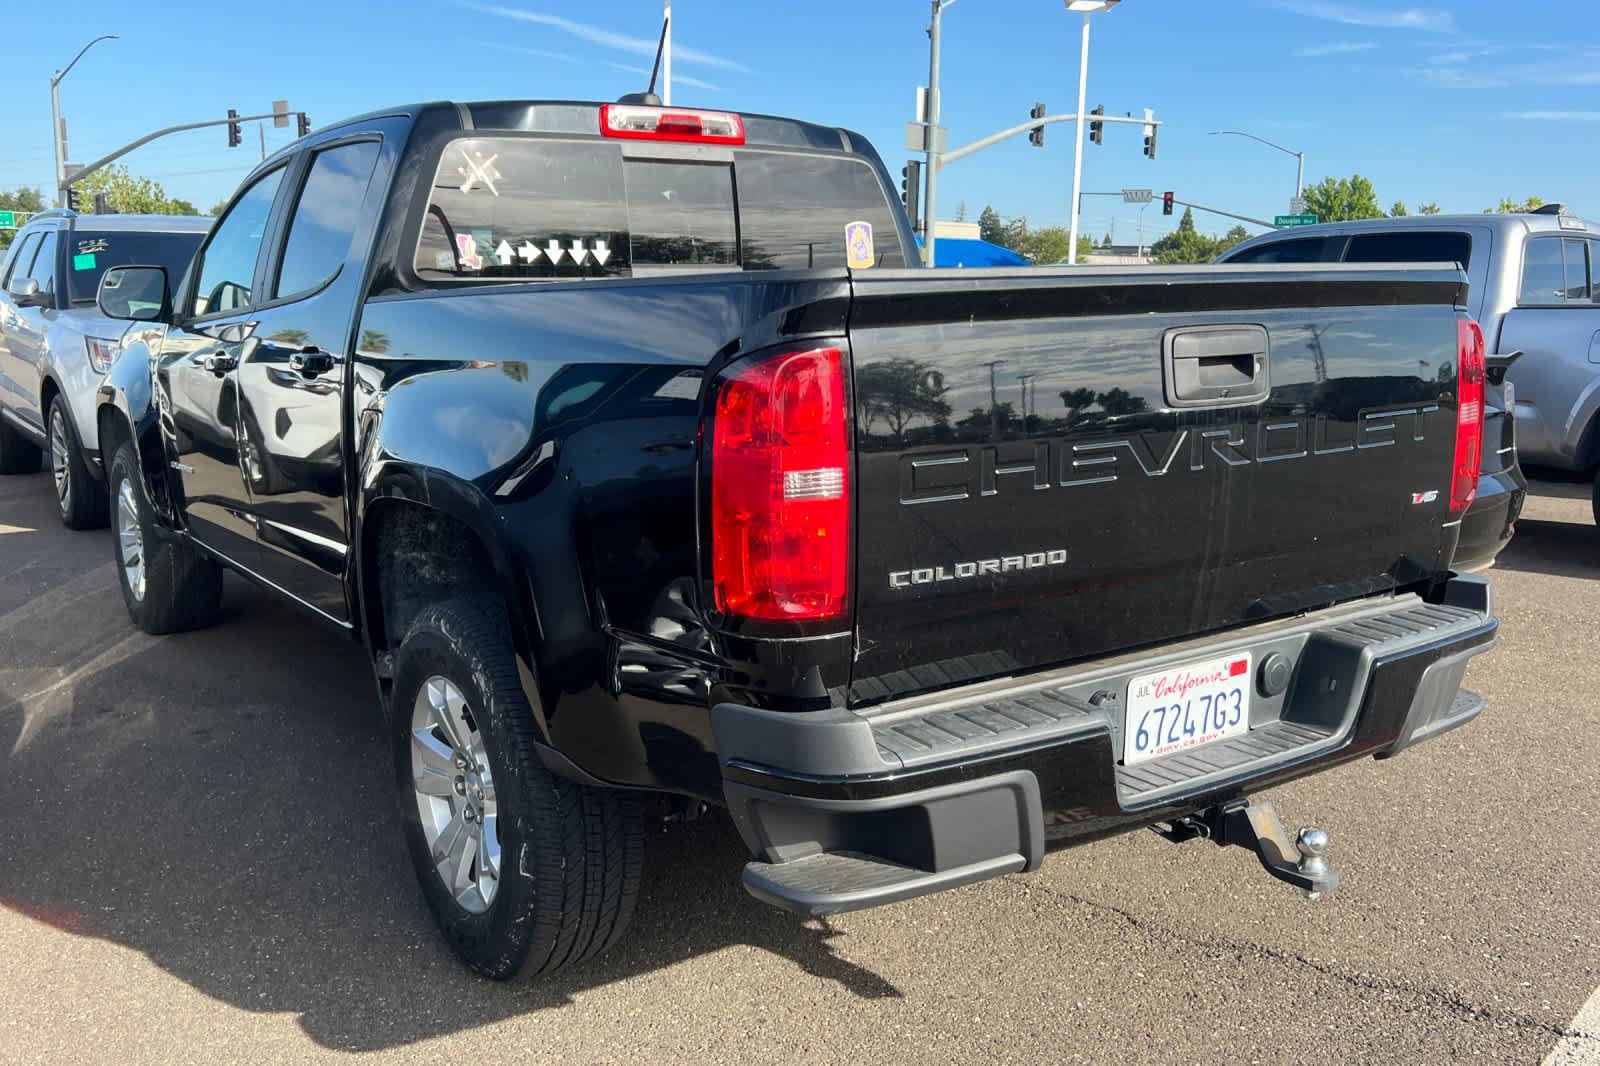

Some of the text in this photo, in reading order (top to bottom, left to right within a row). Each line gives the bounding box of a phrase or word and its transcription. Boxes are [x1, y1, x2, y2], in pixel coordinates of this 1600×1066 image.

[899, 406, 1439, 505] CHEVROLET
[889, 549, 1068, 589] COLORADO
[1154, 671, 1228, 698] California
[1135, 688, 1242, 751] 67247G3
